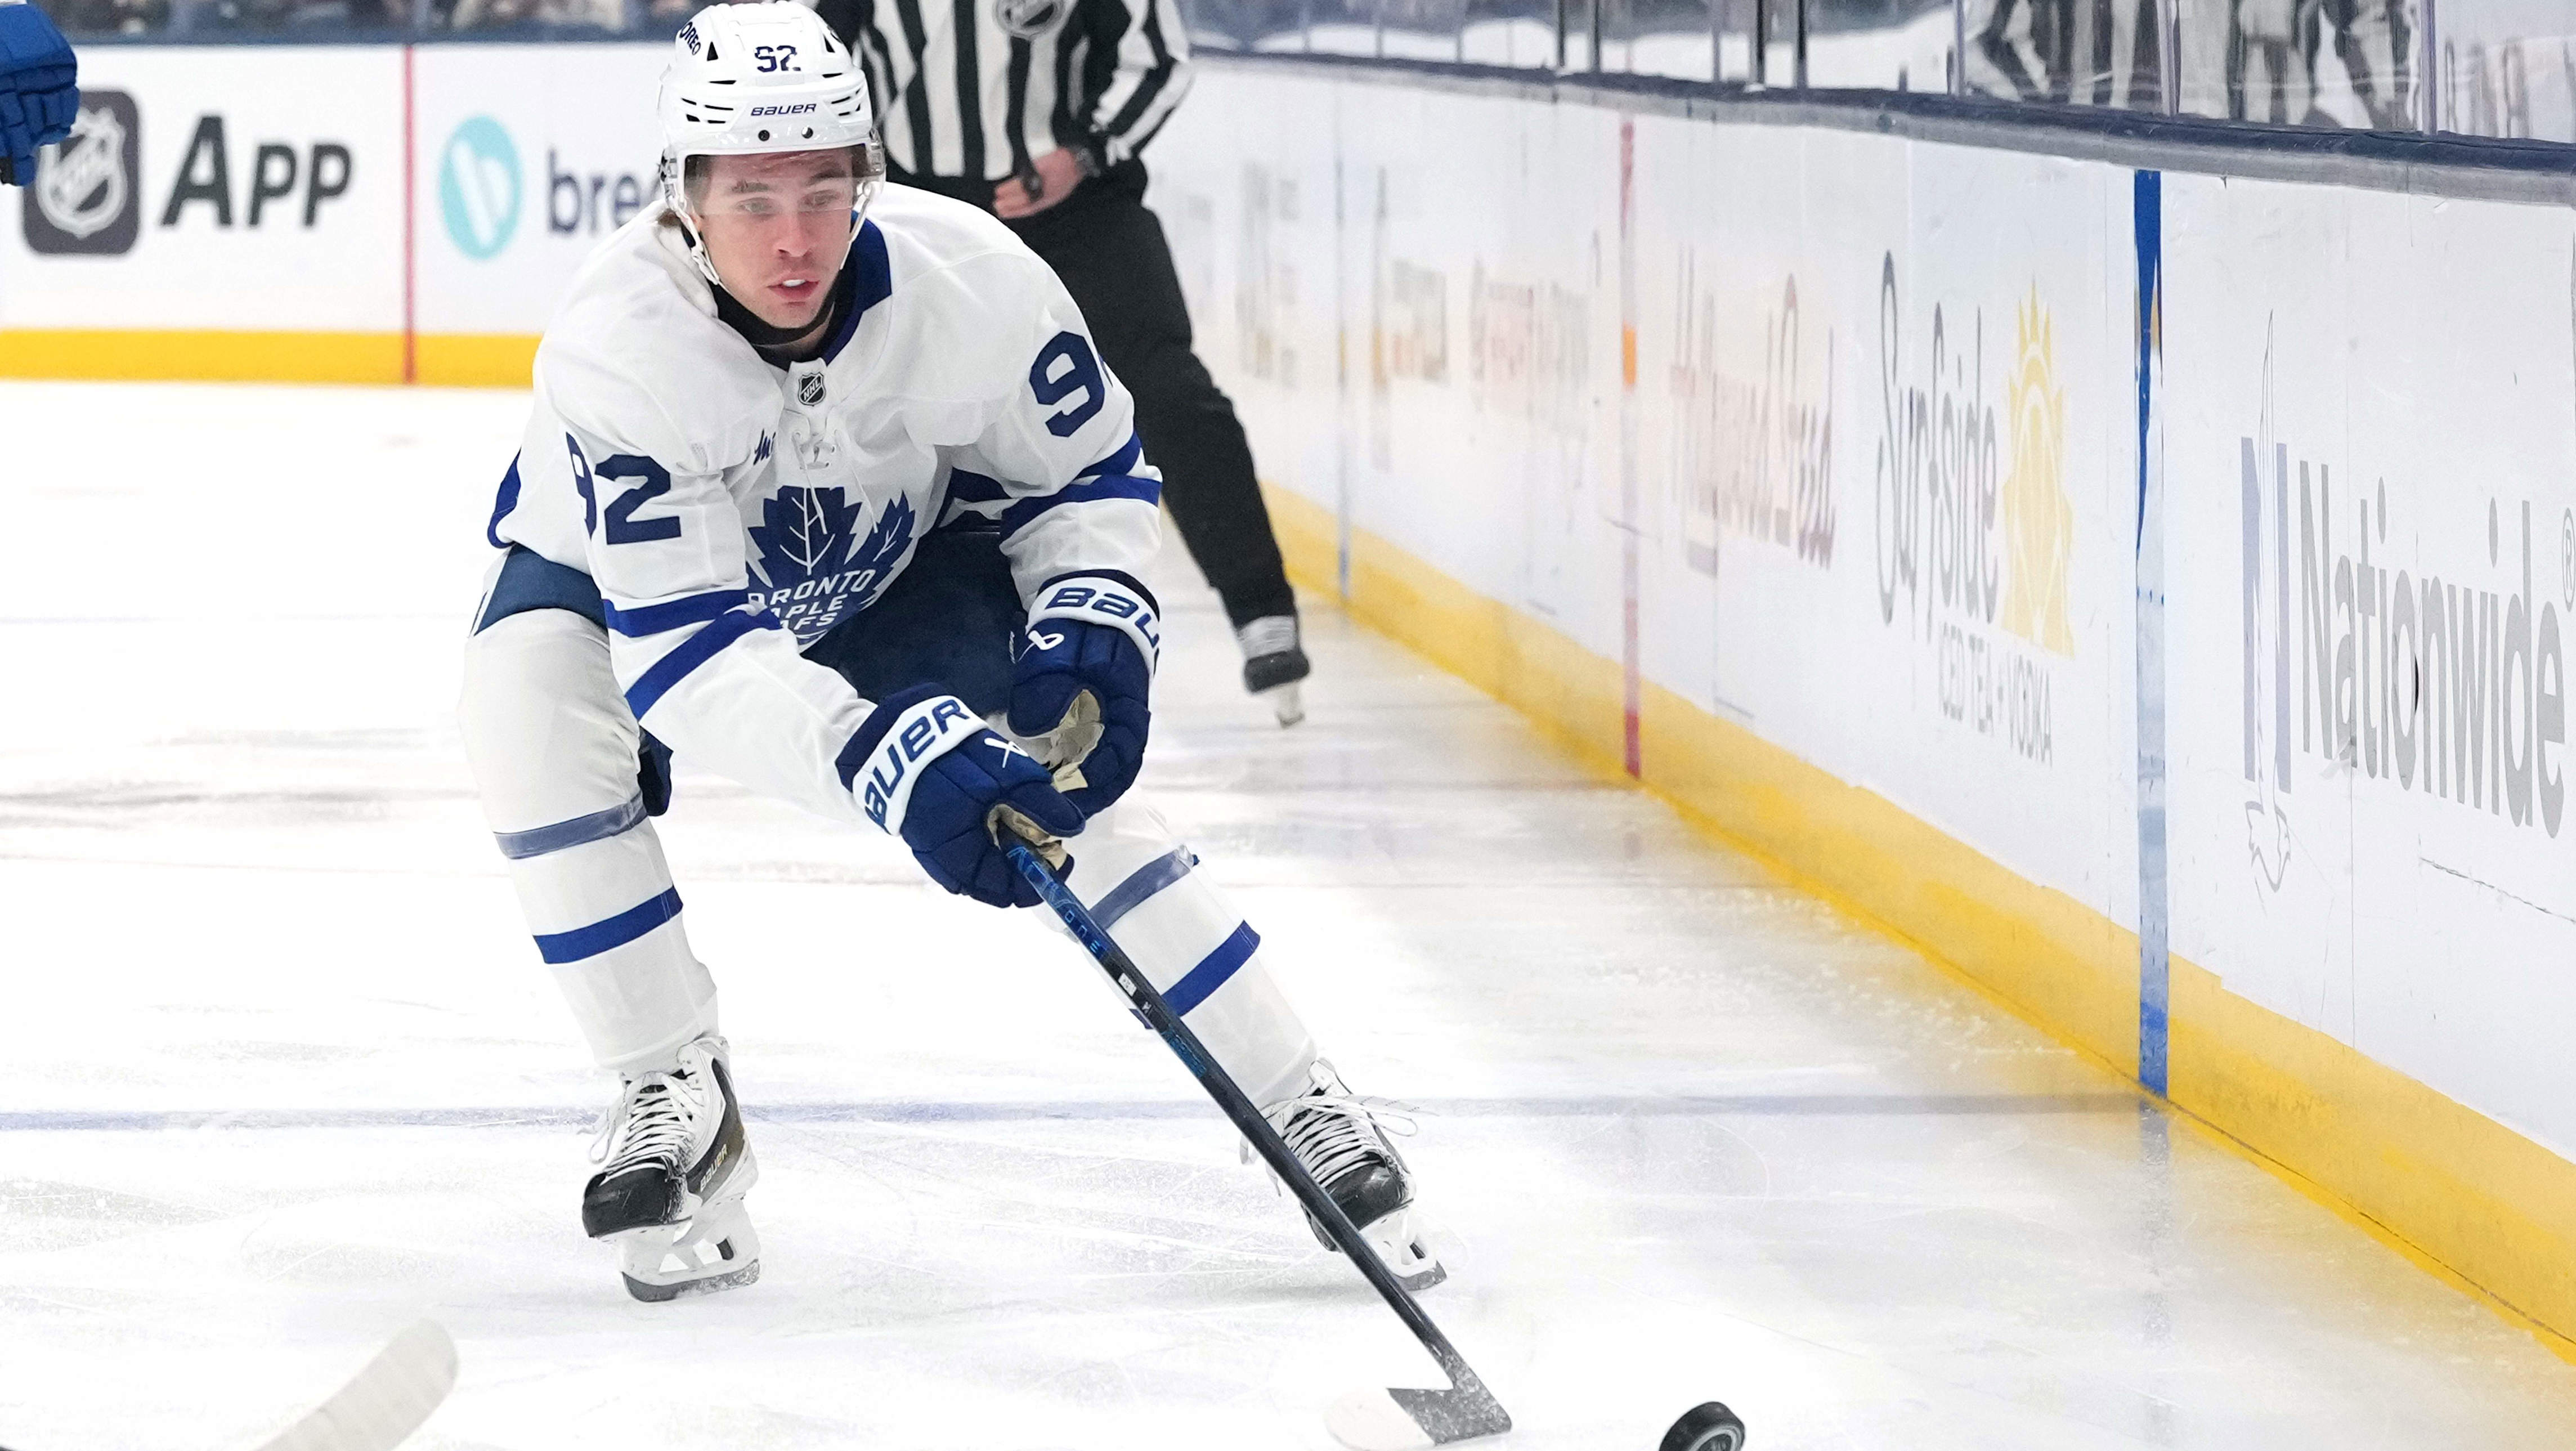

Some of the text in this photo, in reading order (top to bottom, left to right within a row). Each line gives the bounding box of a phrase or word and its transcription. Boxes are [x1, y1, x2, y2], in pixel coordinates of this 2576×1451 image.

[679, 21, 701, 56] OREO
[750, 103, 817, 116] BAUER
[548, 149, 660, 232] bre
[804, 379, 821, 400] NHL
[1028, 330, 1114, 438] 9
[566, 431, 682, 545] 92
[1876, 249, 1998, 643] Surfside
[748, 569, 876, 609] ORONTO
[1045, 587, 1160, 677] BAU
[2007, 650, 2053, 767] VODKA
[864, 698, 970, 835] AUER
[700, 1143, 728, 1192] BAUER
